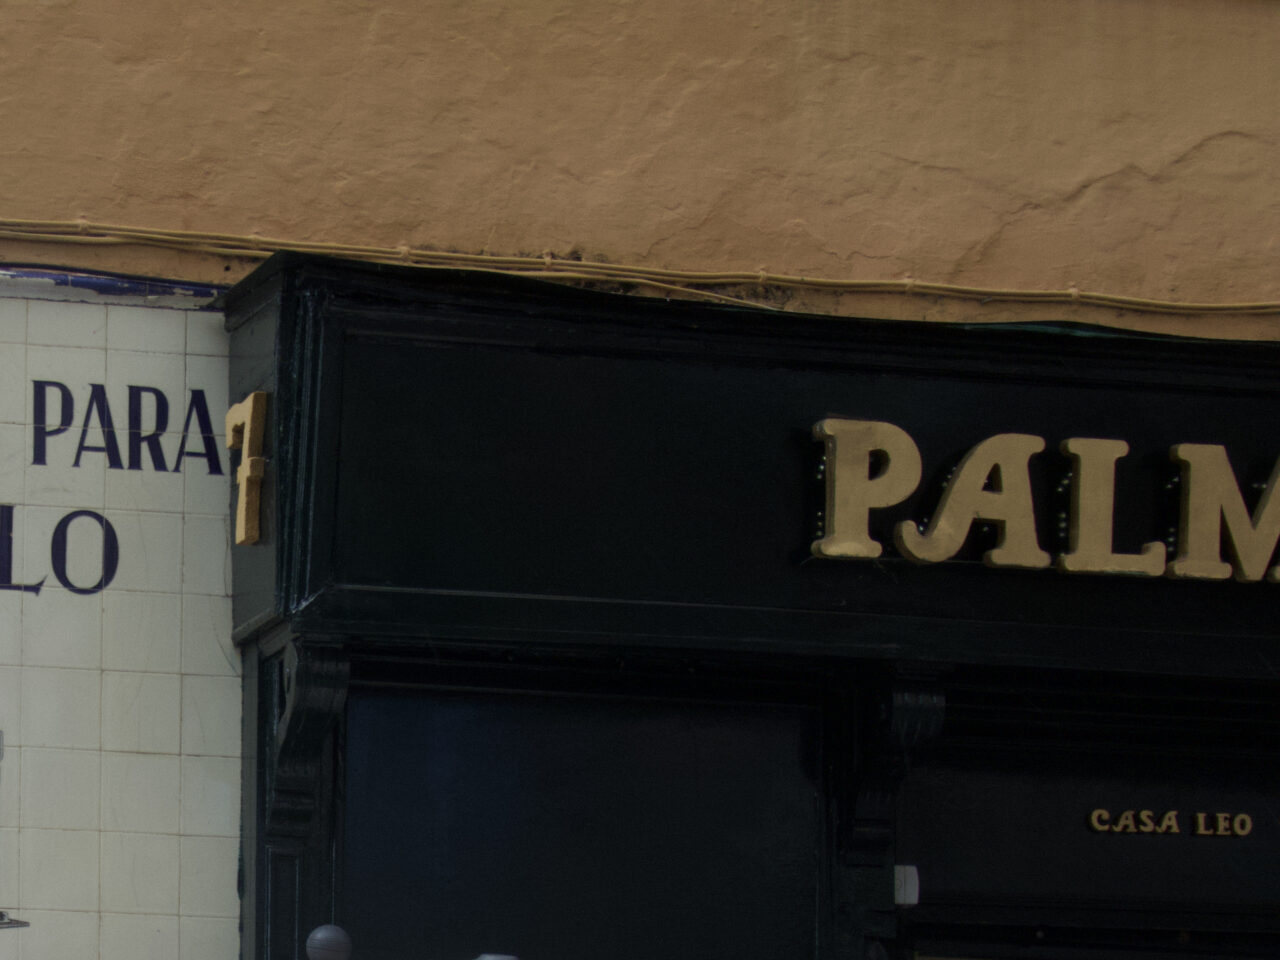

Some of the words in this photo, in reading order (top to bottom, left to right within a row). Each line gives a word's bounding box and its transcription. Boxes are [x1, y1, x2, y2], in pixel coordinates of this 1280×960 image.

[30, 379, 225, 476] PARA
[1088, 808, 1180, 834] CASA
[1194, 812, 1253, 836] LEO
